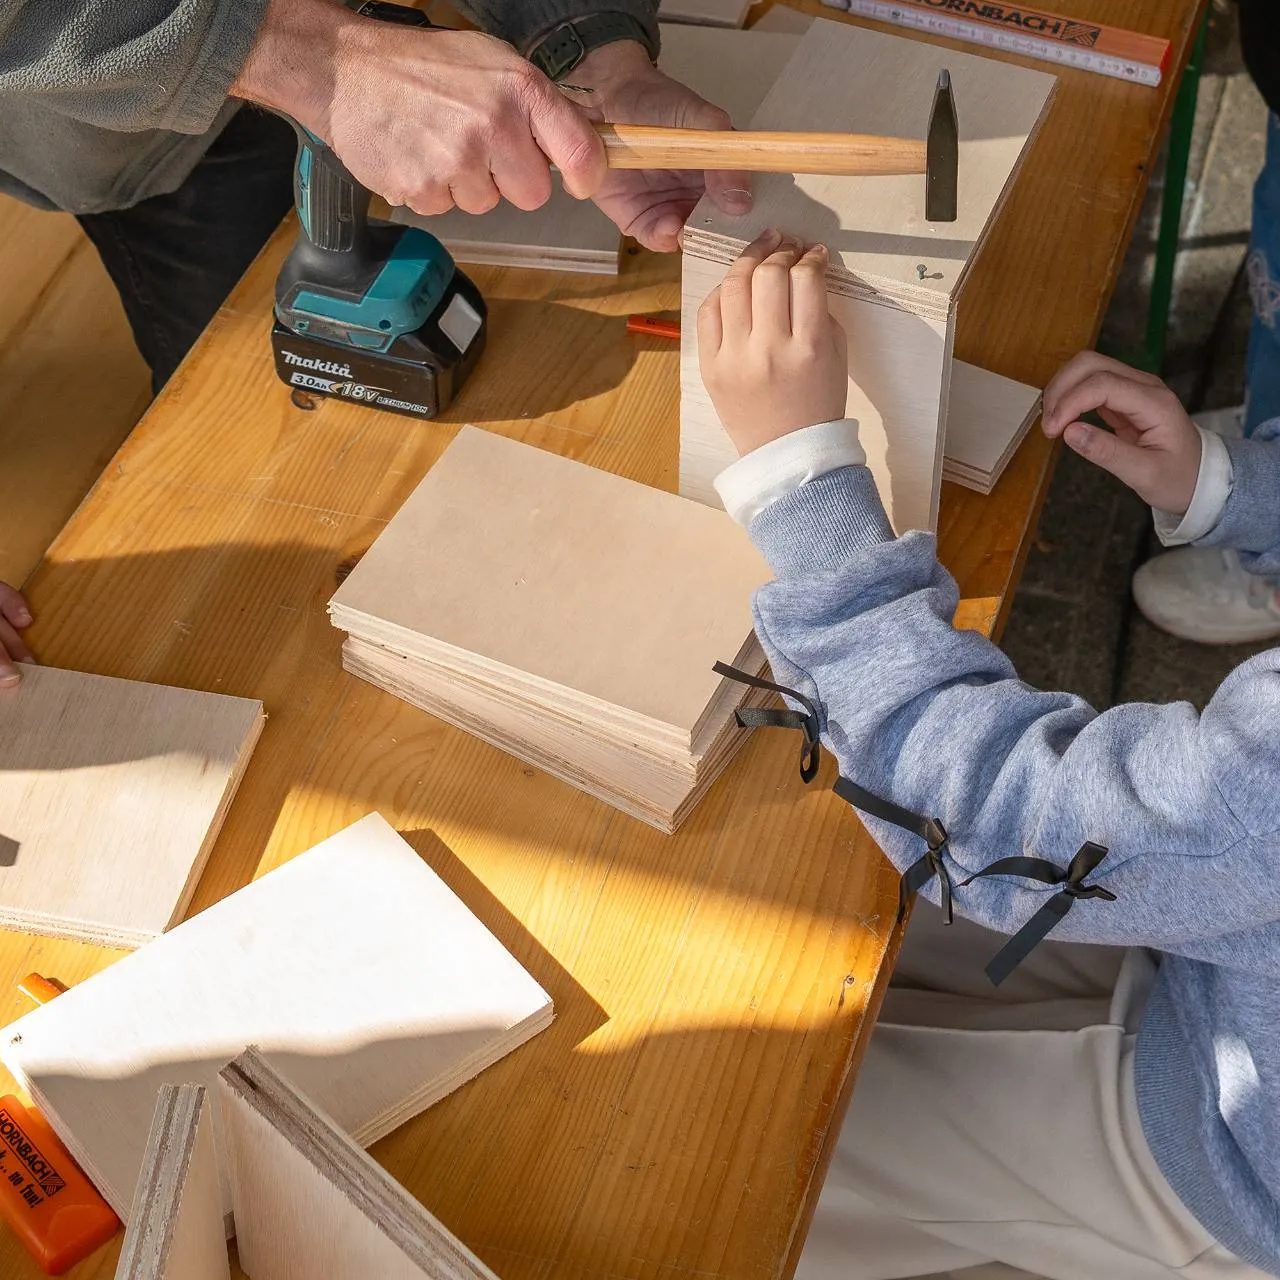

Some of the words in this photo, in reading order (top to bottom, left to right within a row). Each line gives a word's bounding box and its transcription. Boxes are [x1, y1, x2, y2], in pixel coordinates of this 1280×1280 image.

[293, 373, 328, 391] 3.0Ah
[8, 1170, 25, 1187] no
[20, 1183, 44, 1208] fun!
